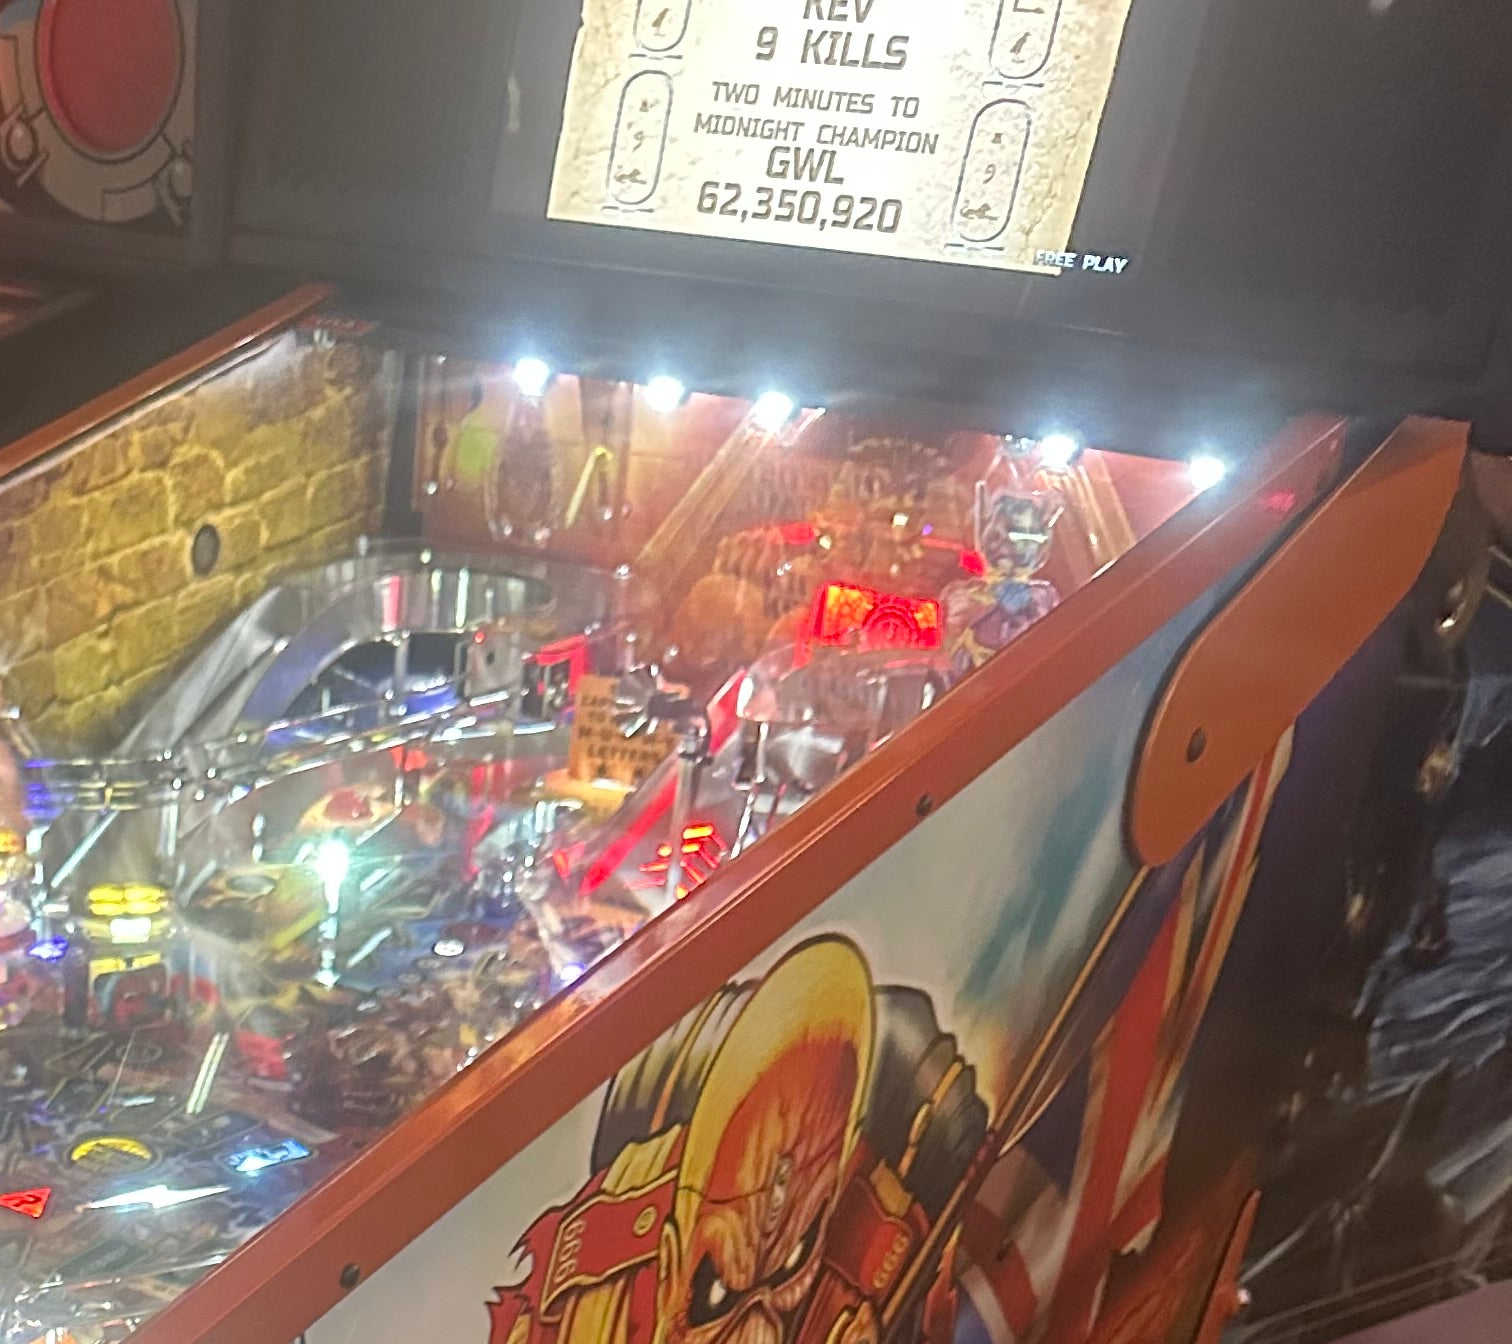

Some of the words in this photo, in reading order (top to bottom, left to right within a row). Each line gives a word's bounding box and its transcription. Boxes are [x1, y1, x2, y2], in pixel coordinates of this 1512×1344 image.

[755, 26, 778, 61] 9
[800, 29, 909, 70] KILLS
[712, 81, 760, 105] TWO
[773, 86, 876, 114] MINUTES
[891, 96, 920, 119] TO
[693, 112, 805, 142] MIDNIGHT
[816, 124, 939, 155] CHAMPION
[766, 145, 844, 184] GWL
[696, 180, 903, 234] 62,350,920
[1036, 250, 1077, 268] FREE
[1082, 254, 1129, 275] PLAY
